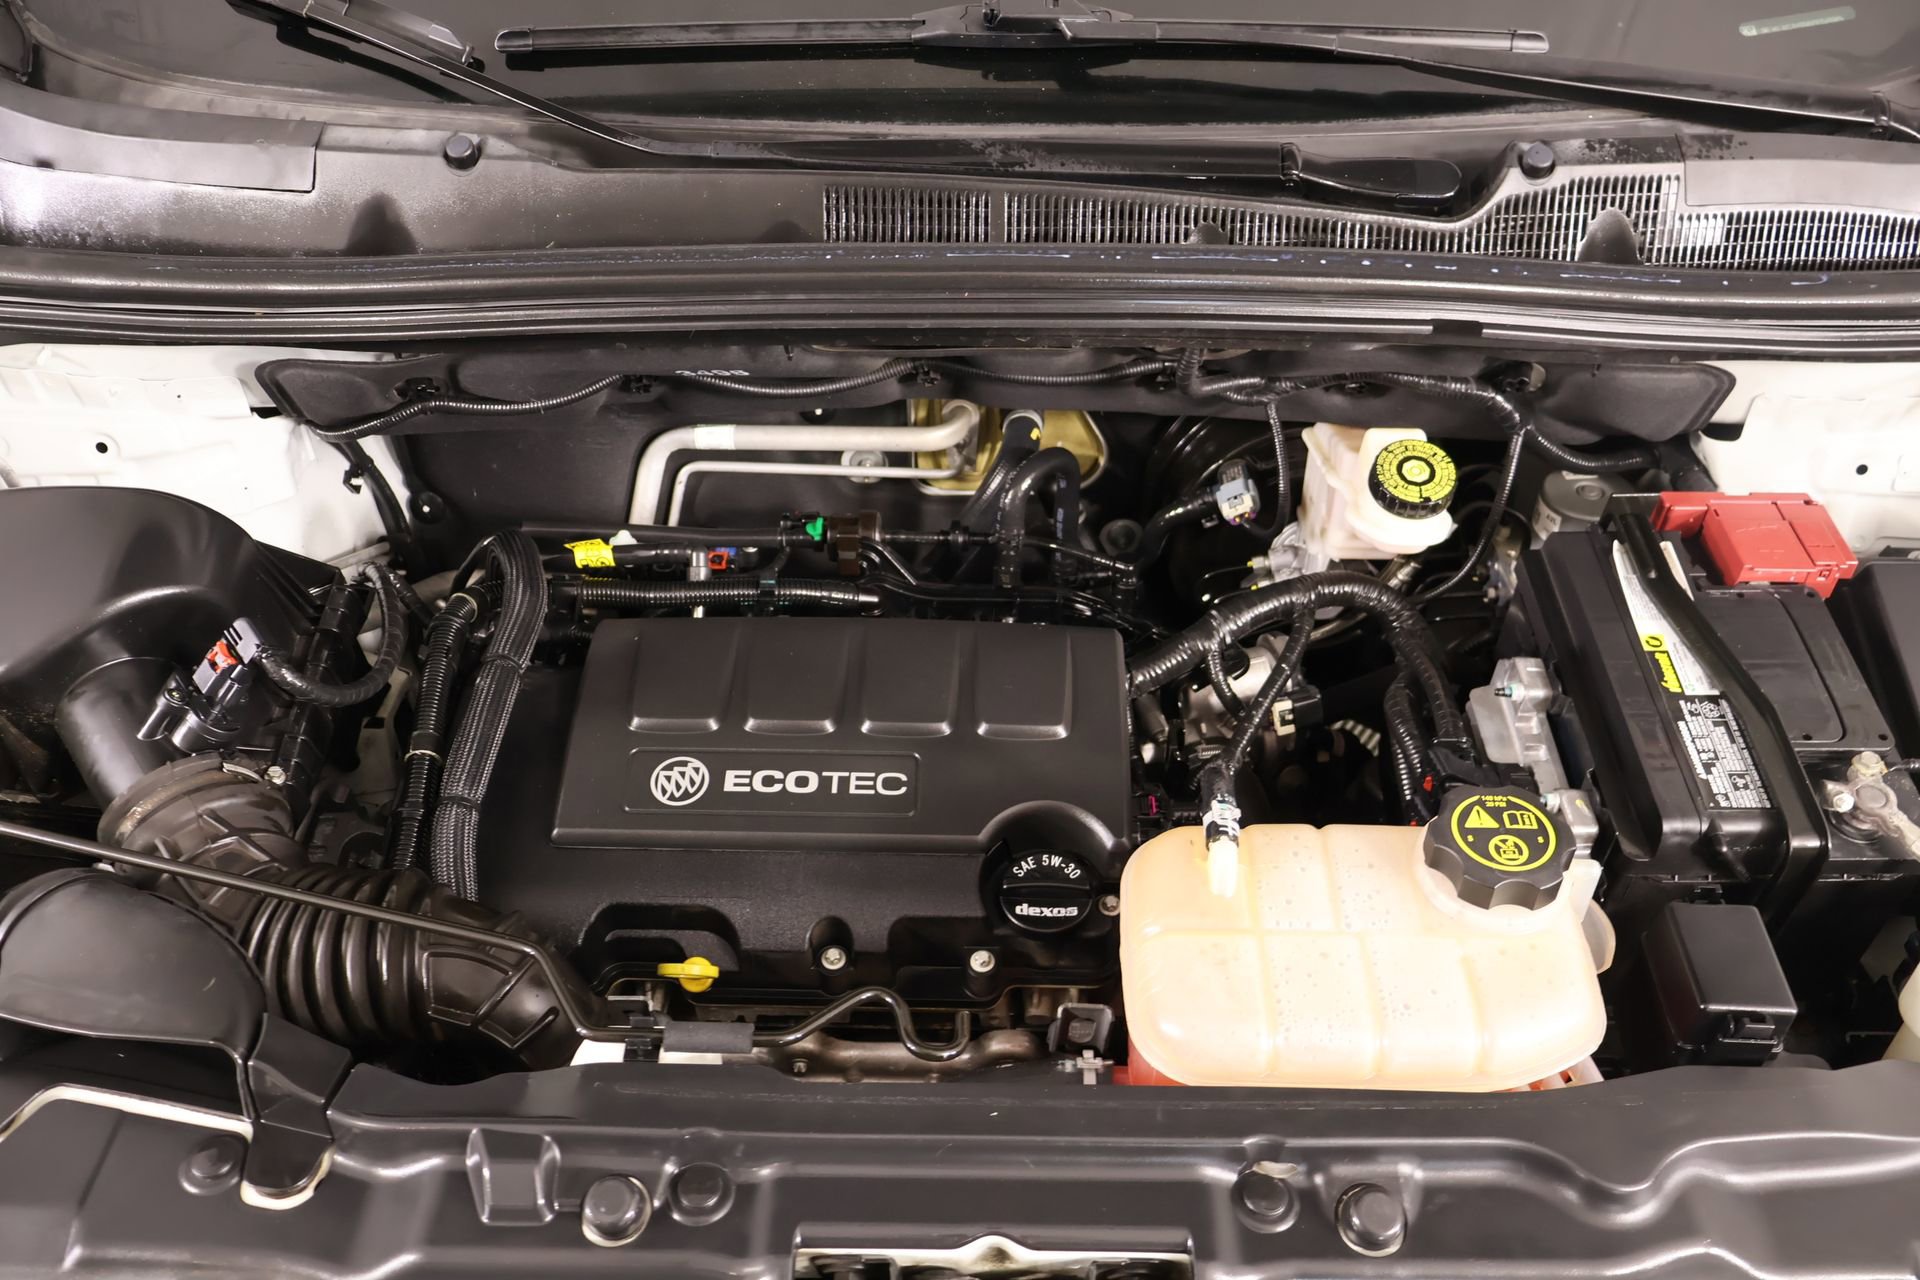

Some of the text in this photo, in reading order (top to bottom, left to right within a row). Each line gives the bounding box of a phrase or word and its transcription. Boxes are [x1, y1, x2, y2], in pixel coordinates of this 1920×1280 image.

[723, 769, 908, 796] ECOTEC
[1012, 854, 1081, 879] SAE 5W-30
[1015, 903, 1078, 917] dexos
